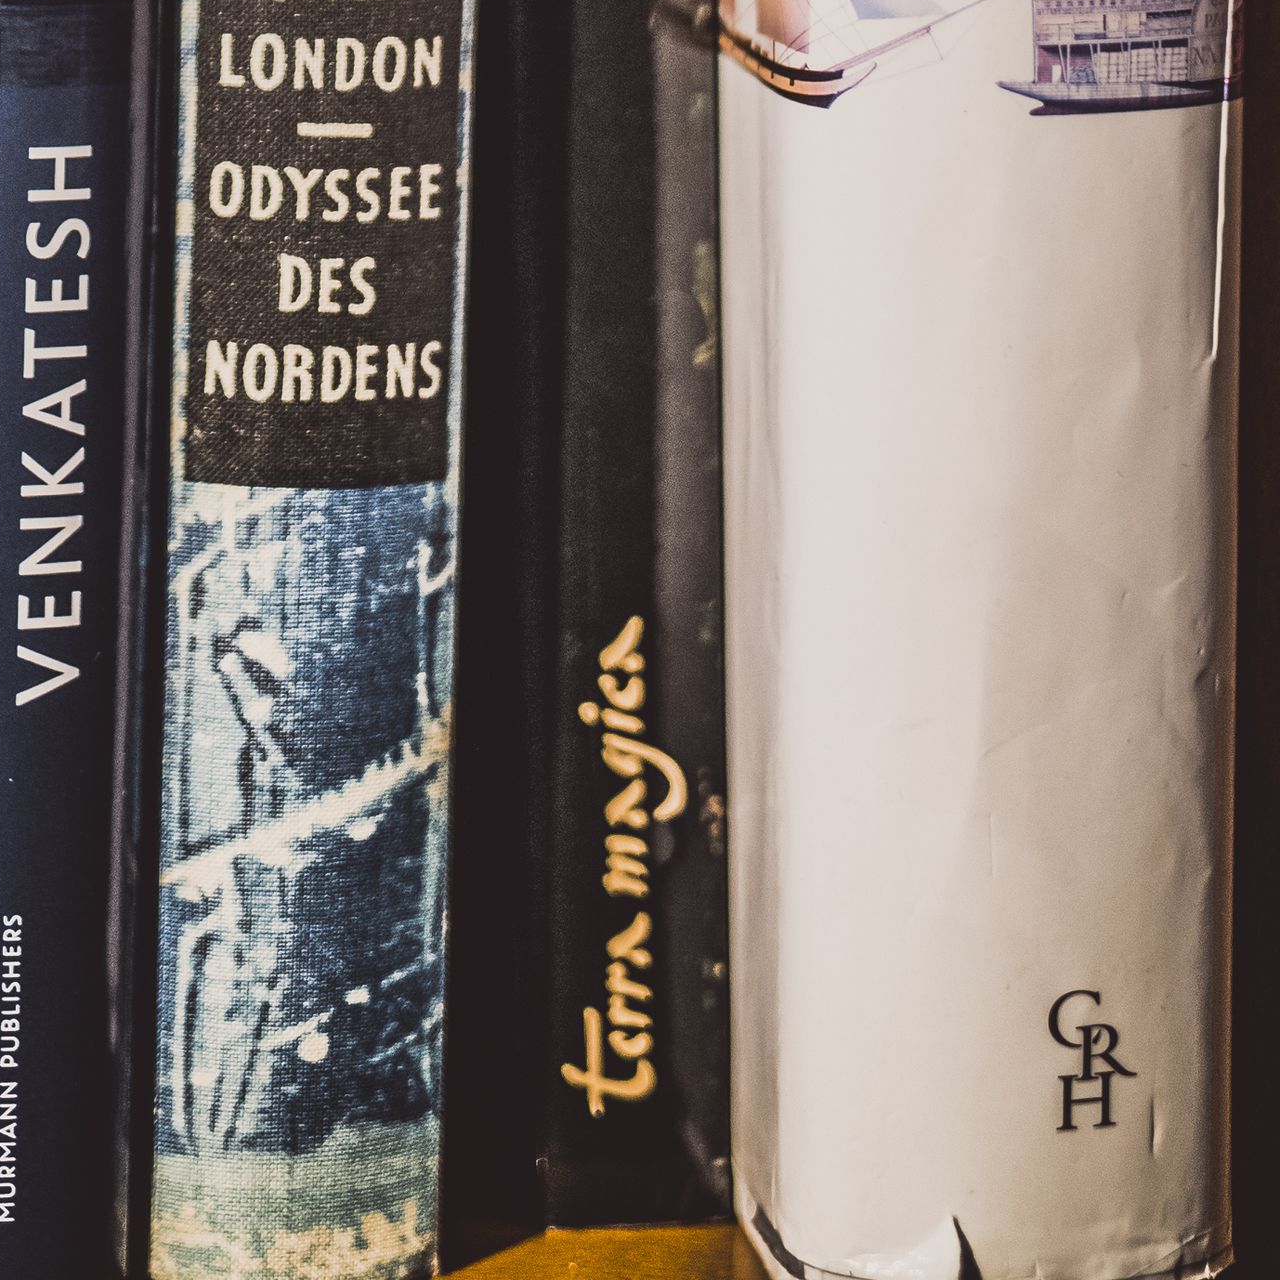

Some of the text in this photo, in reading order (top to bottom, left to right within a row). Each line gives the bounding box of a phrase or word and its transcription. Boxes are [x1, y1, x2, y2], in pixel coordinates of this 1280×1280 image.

[218, 33, 443, 93] LONDON
[208, 160, 442, 224] ODYSSEE
[276, 252, 376, 316] DES
[203, 339, 442, 404] NORDENS
[15, 144, 93, 707] VENKATESH
[0, 914, 23, 1068] PUBLISHERS
